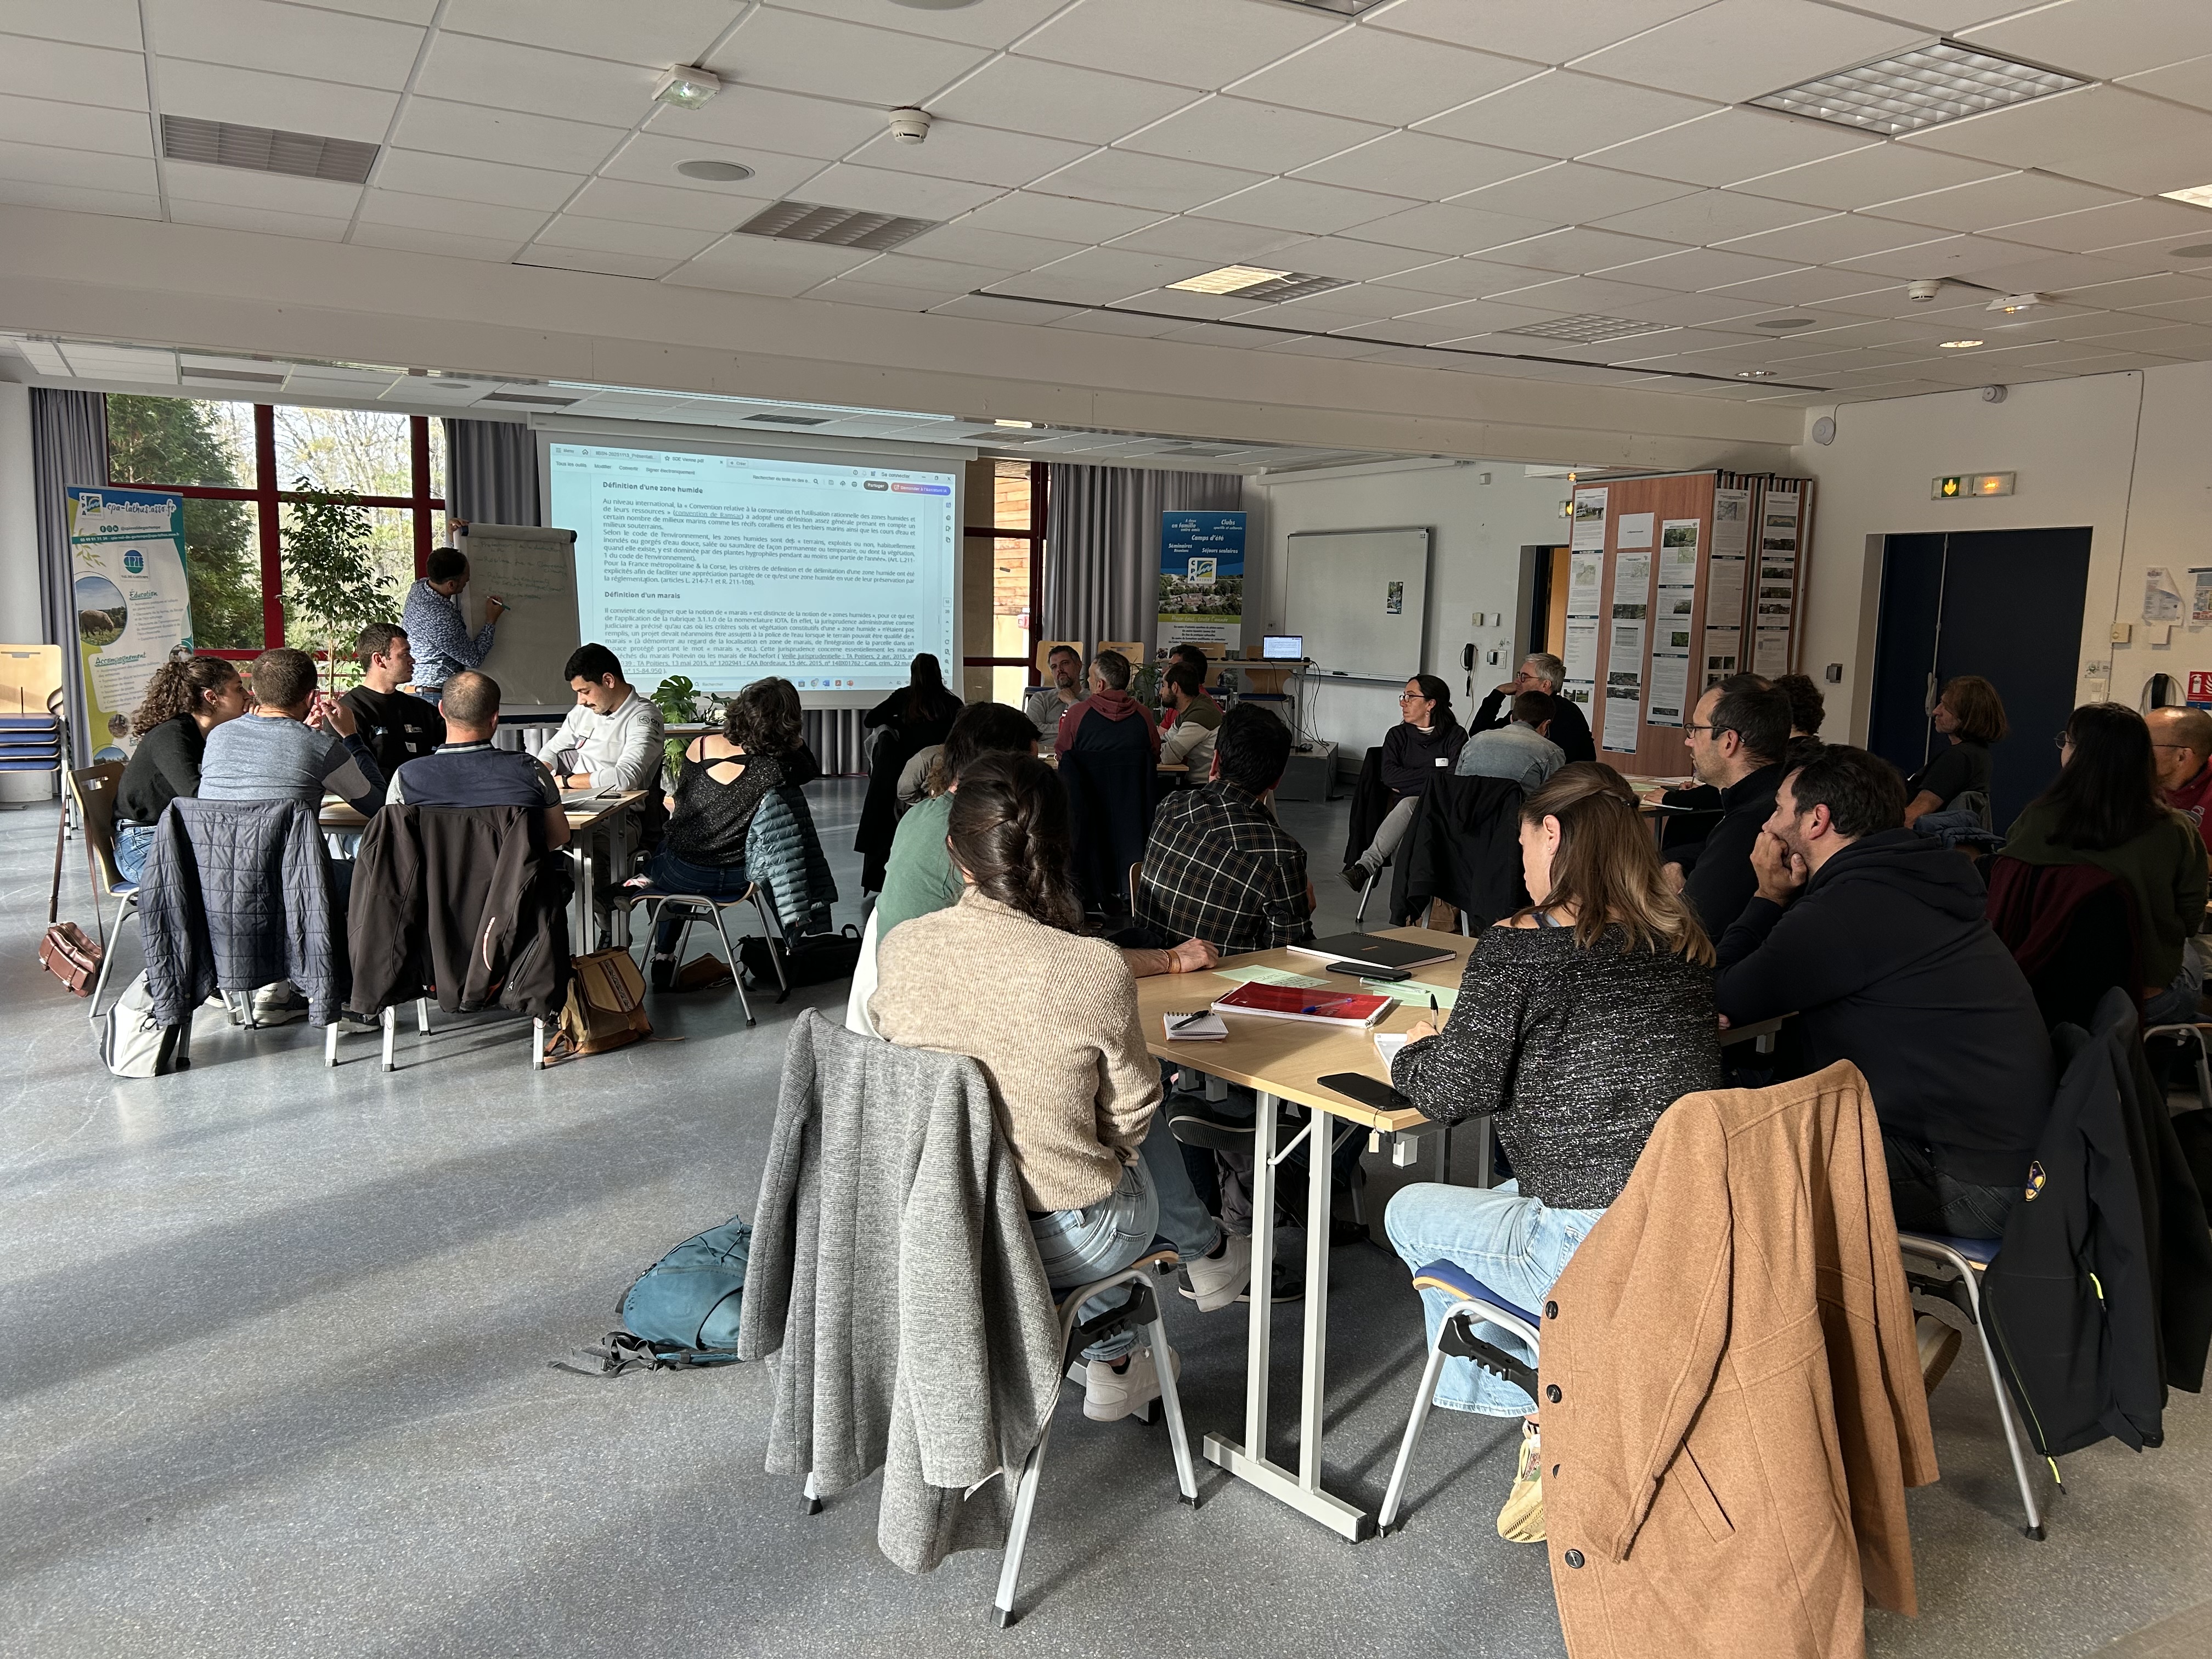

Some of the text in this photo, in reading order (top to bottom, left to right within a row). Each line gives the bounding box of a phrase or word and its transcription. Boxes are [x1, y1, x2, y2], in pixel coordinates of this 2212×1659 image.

[603, 481, 638, 489] Définition
[107, 500, 176, 517] cpa-lathus.asso.fr
[650, 562, 695, 571] métropolitaine
[129, 589, 158, 598] Éducation
[95, 651, 146, 665] Accompagnement
